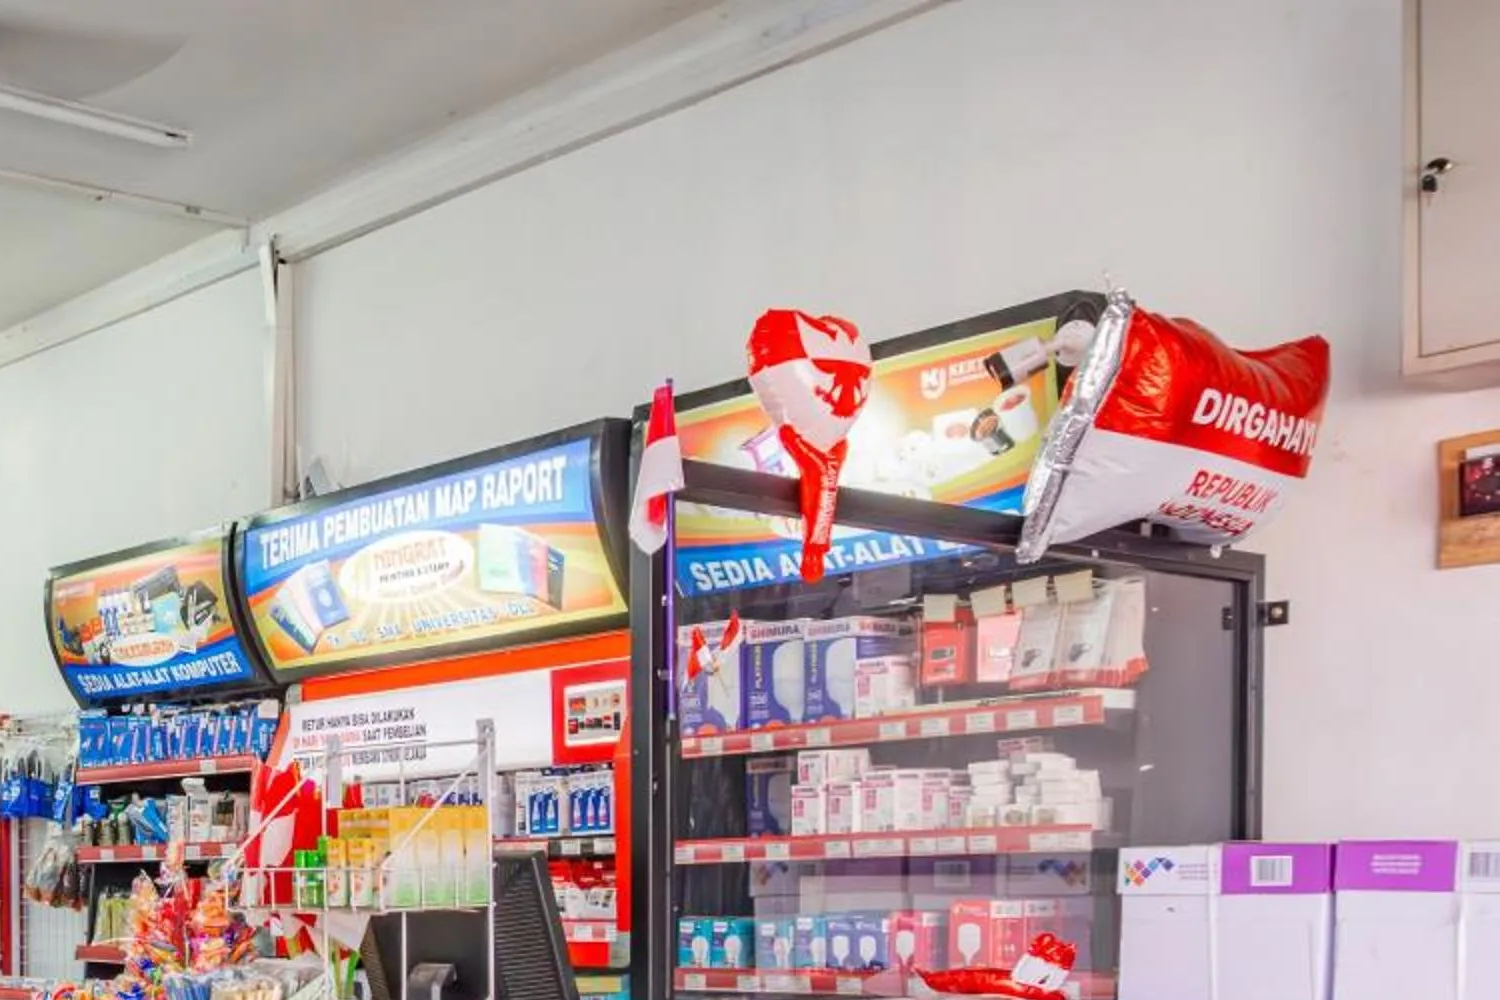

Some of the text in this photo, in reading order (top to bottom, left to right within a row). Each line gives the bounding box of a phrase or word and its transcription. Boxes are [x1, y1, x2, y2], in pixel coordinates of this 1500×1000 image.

[260, 456, 569, 569] TERIMA PEMBUATAN MAP RAPORT
[1185, 469, 1278, 513] REPUBLIK
[689, 554, 776, 592] SEDIA
[78, 671, 115, 694] SEDIA
[170, 651, 242, 682] KOMPUTER
